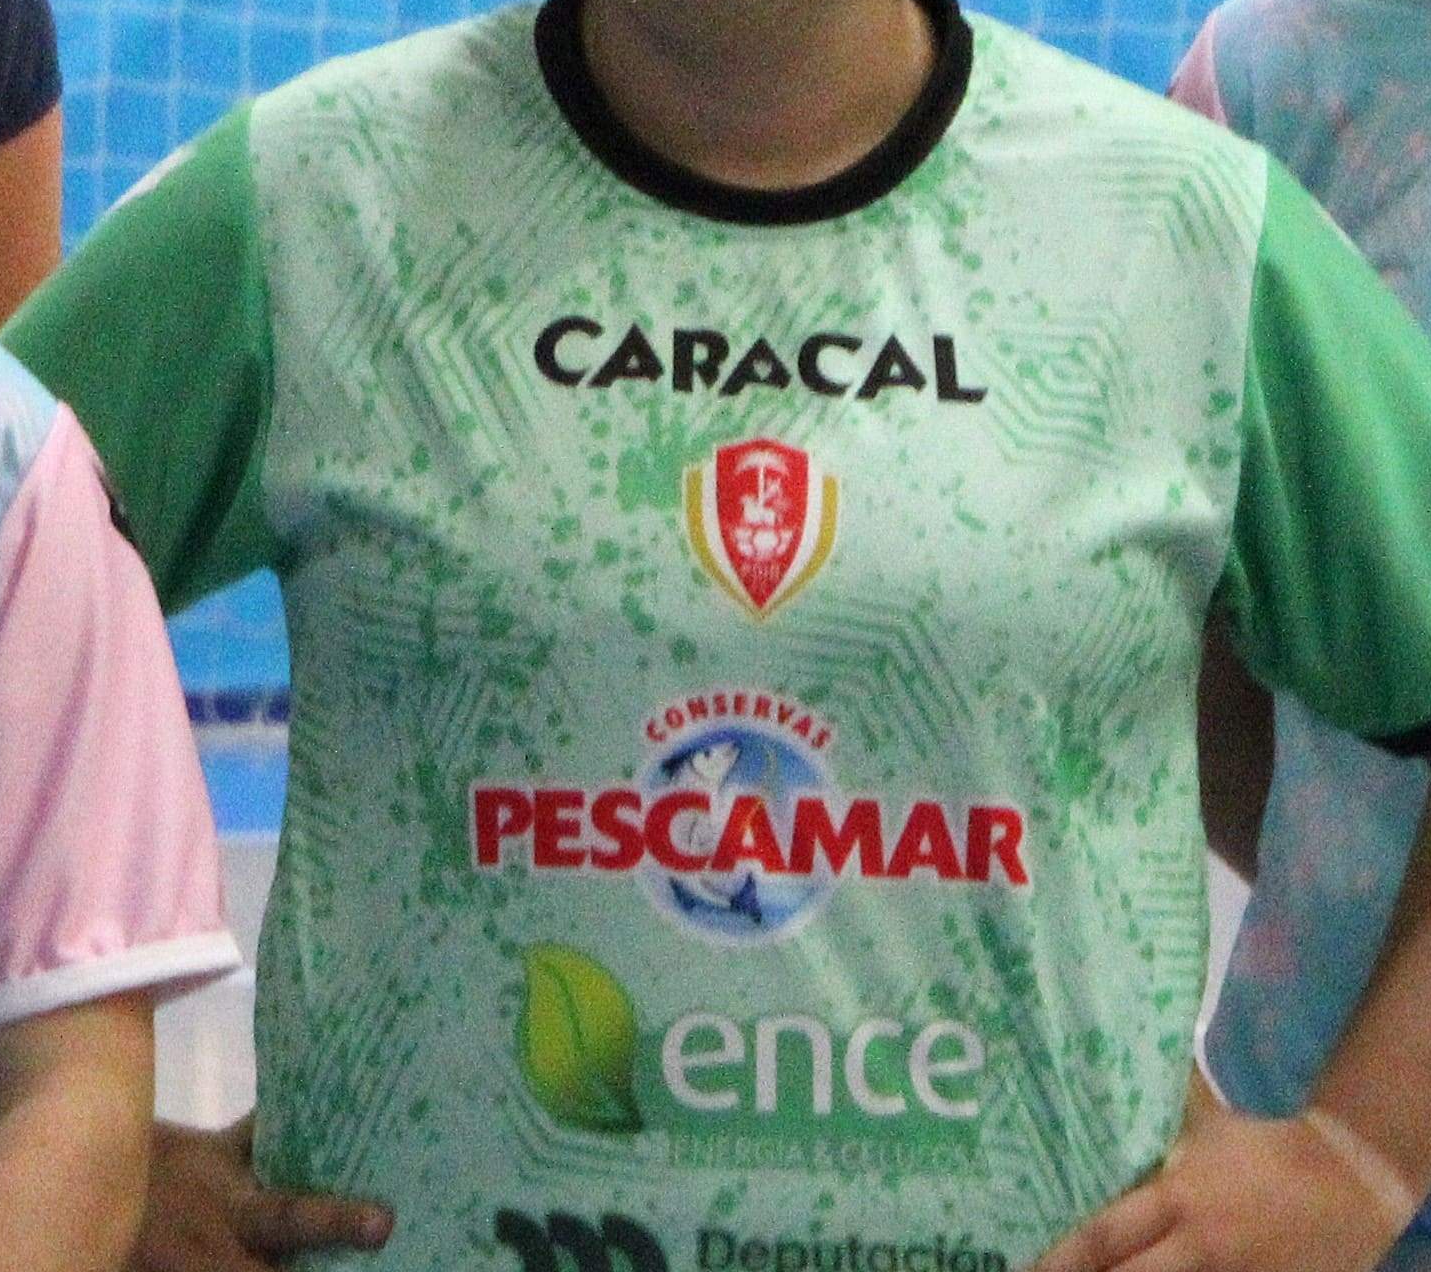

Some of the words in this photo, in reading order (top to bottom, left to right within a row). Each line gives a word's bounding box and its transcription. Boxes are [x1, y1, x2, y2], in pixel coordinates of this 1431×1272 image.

[533, 315, 989, 404] CARACAL
[645, 692, 834, 750] CONSERVAS
[473, 787, 1030, 887] PESCAMAR
[661, 1013, 986, 1118] ence
